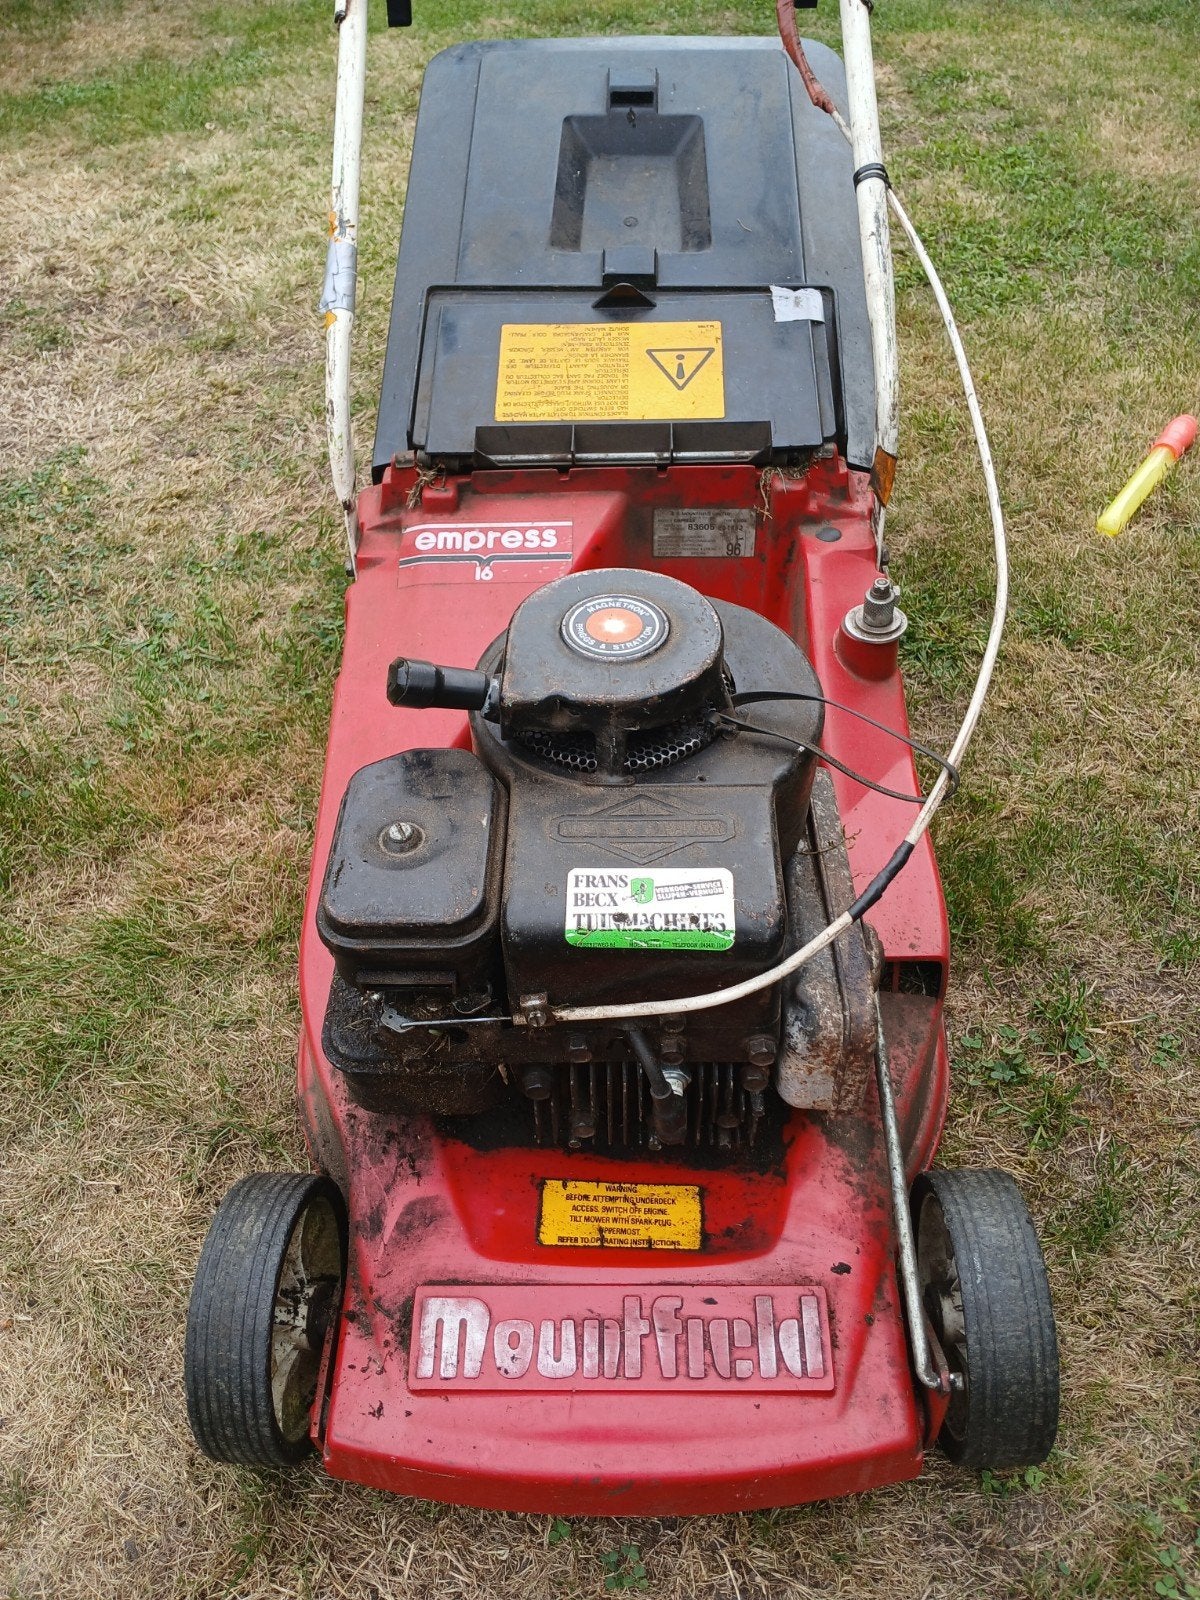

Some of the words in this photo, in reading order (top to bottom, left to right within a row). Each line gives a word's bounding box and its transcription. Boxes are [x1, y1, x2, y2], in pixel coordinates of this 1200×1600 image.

[414, 528, 558, 552] empress
[726, 542, 741, 556] 96
[474, 566, 494, 581] 16
[575, 623, 596, 646] BRIGGS
[612, 626, 654, 650] STRATTON
[574, 874, 628, 888] FRANS
[573, 892, 619, 907] BECX
[605, 1185, 637, 1193] WARNING
[593, 1195, 635, 1204] ATTEMPTING
[636, 1197, 676, 1205] UNDERDECK
[599, 1227, 641, 1236] PPERMOST.
[416, 1295, 825, 1380] Mountfield
